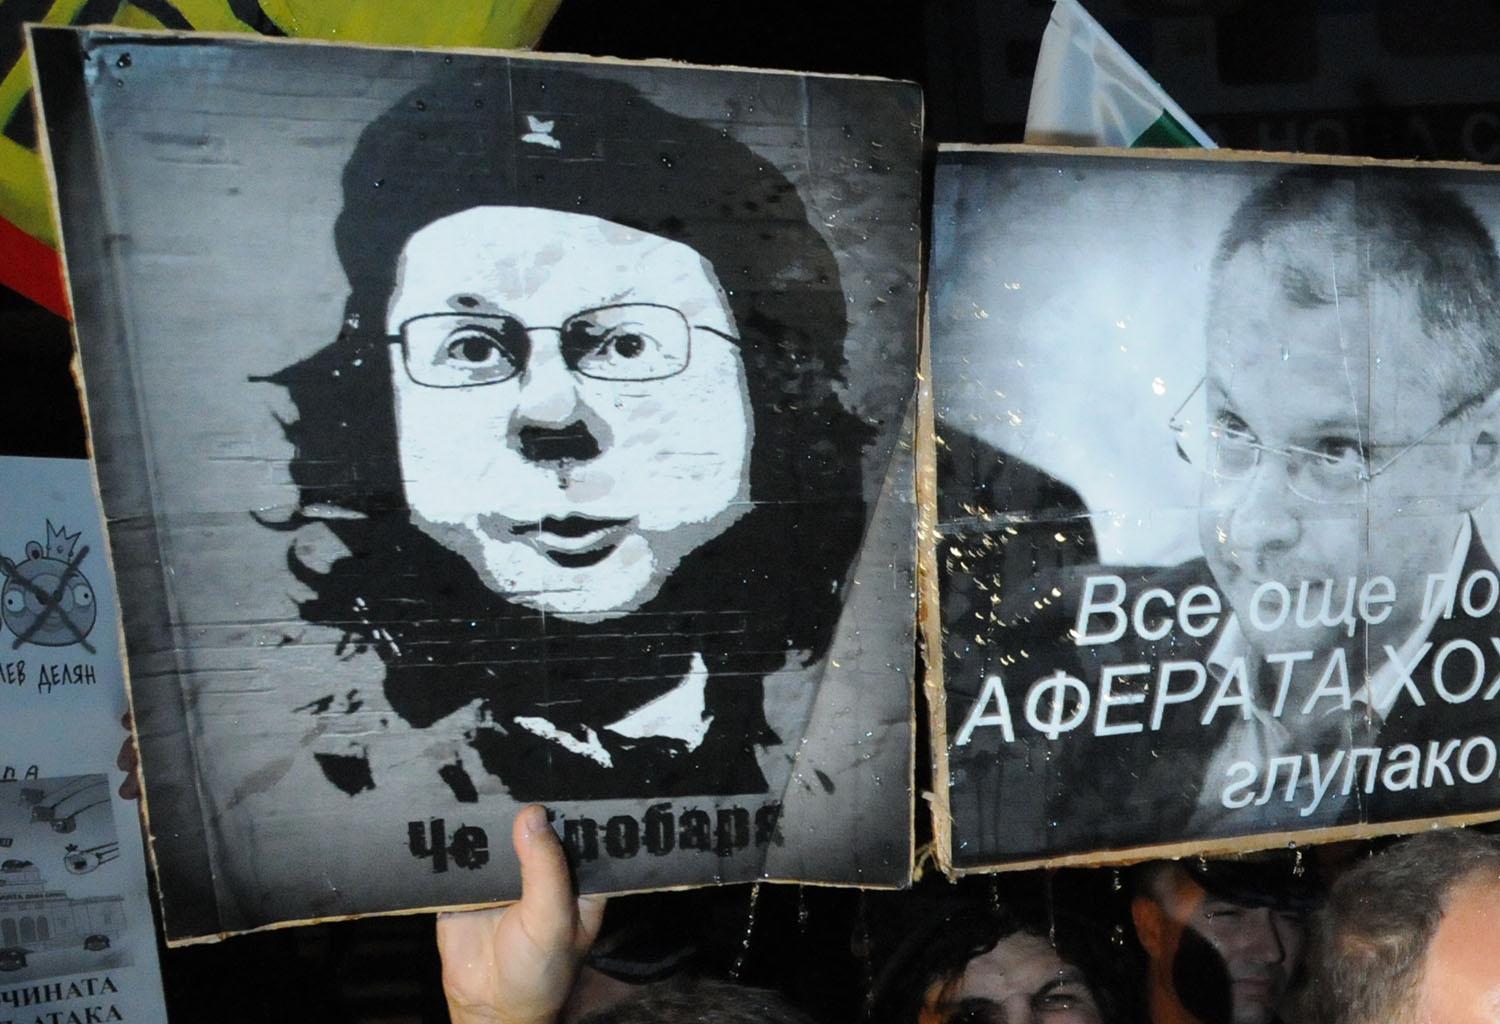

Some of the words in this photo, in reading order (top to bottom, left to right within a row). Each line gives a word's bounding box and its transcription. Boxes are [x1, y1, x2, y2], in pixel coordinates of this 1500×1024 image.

[1075, 573, 1221, 647] Все
[1249, 573, 1396, 637] още
[38, 663, 97, 694] ДЕЛЯН
[955, 648, 1355, 748] АФЕРАТА
[405, 816, 489, 874] Че
[547, 801, 784, 862] робаря
[0, 976, 118, 1008] ЧИНАТА
